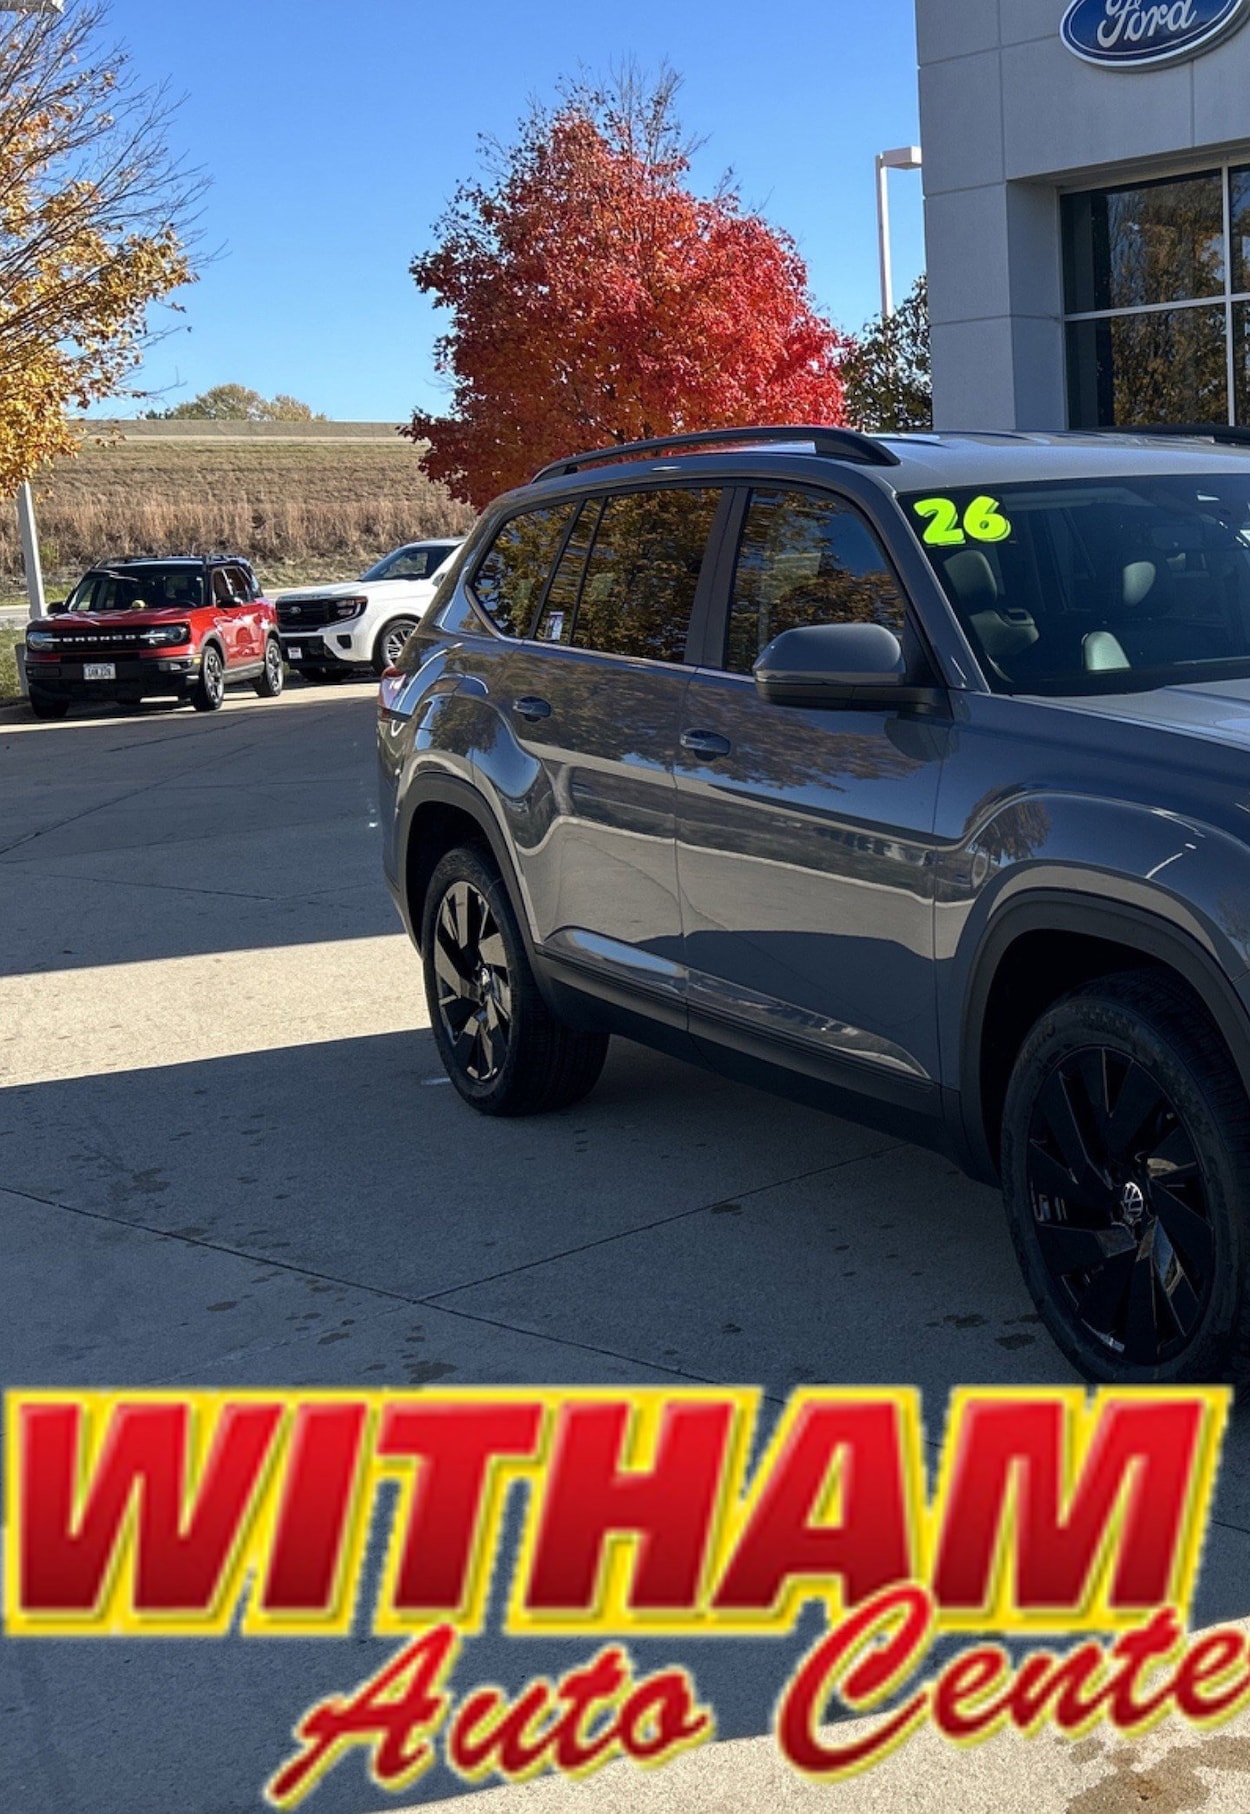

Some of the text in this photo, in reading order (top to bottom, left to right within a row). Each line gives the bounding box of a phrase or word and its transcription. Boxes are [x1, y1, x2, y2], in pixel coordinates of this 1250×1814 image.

[1097, 0, 1197, 47] Ford
[913, 495, 1012, 546] 26
[62, 634, 136, 643] BRONCO
